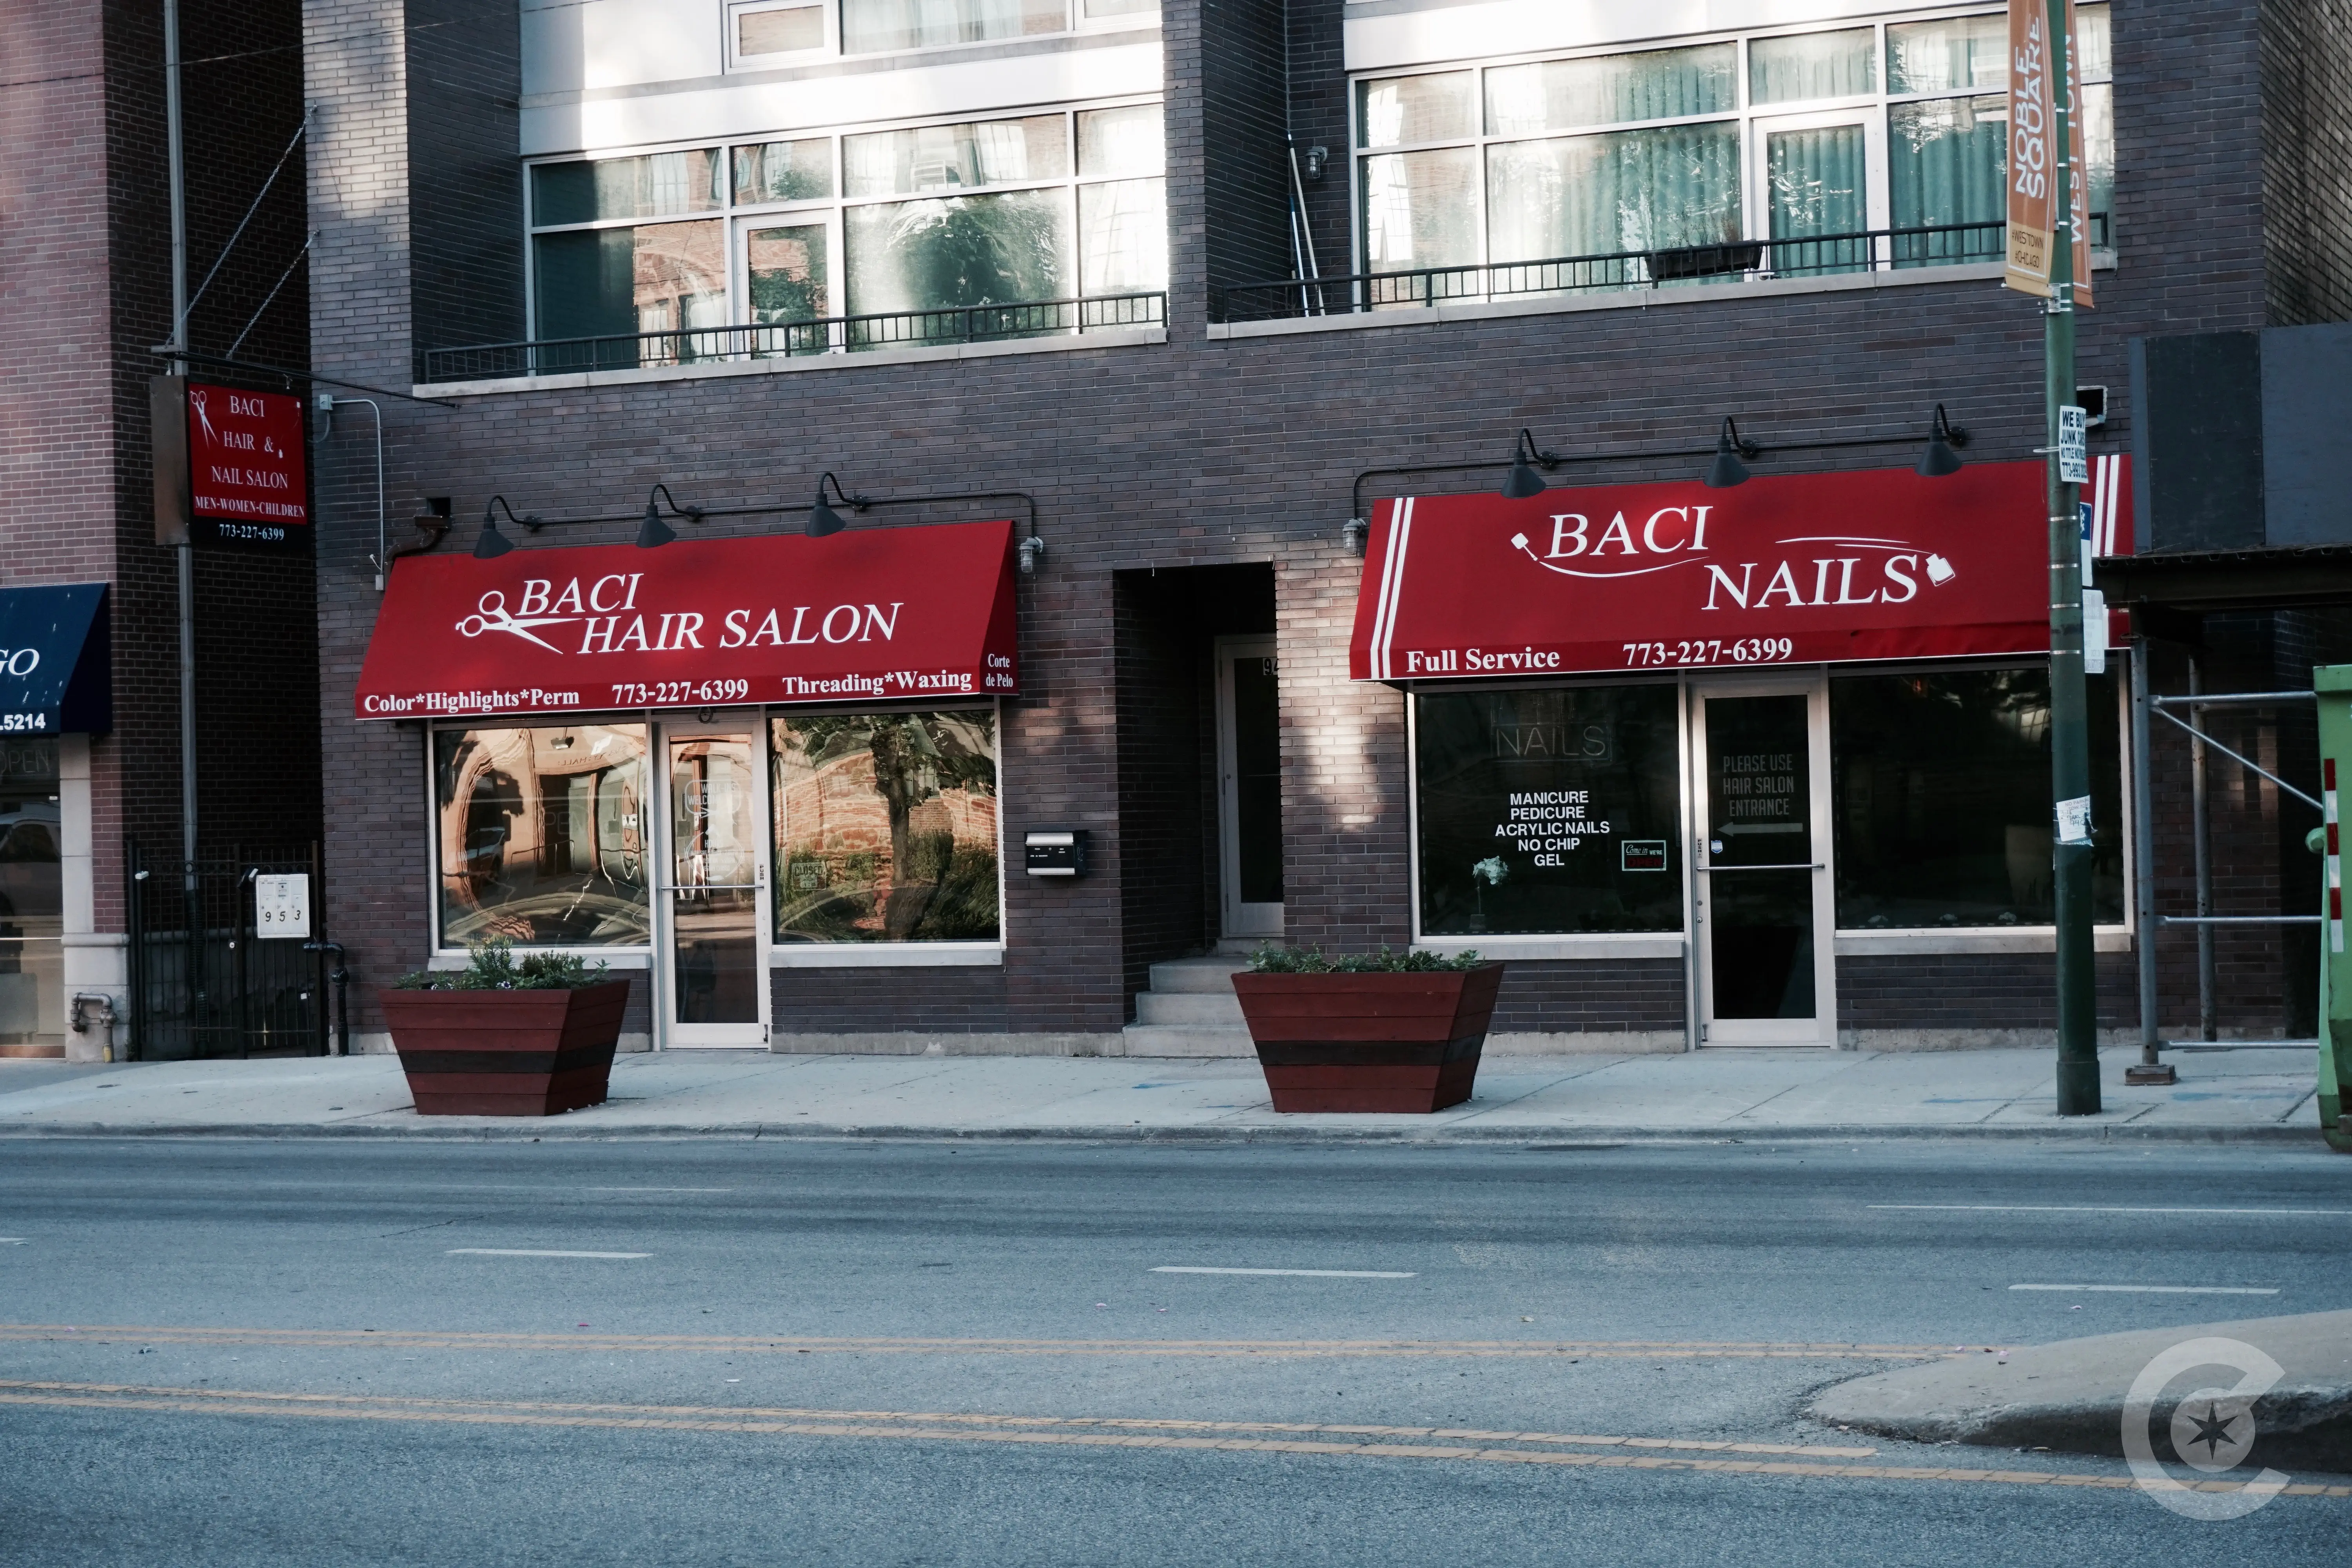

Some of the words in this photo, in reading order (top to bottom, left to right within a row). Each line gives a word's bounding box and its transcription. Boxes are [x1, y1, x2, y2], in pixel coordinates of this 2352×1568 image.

[2027, 17, 2045, 199] SQUARE
[2015, 46, 2029, 193] NOBLE
[230, 395, 265, 417] BACI
[2062, 411, 2074, 427] WE
[2076, 412, 2085, 429] BUY
[224, 431, 255, 450] HAIR
[265, 436, 274, 452] &
[2061, 429, 2076, 445] JUNK
[212, 466, 243, 485] NAIL
[247, 469, 288, 489] SALON
[195, 496, 305, 517] MEN-WOMEN-CHILDREN
[219, 524, 284, 541] 773-227-6399
[1544, 506, 1713, 558] BACI
[1701, 554, 1918, 610] NAILS
[515, 573, 644, 616] BACI
[577, 612, 704, 654] HAIR
[719, 603, 904, 648] SALON
[988, 653, 1010, 668] Corte
[1406, 649, 1458, 673] Full
[1466, 647, 1560, 671] Service
[1623, 638, 1792, 666] 773-227-6399
[985, 673, 996, 688] de
[997, 674, 1013, 688] Pelo
[612, 679, 749, 704] 773-227-6399
[1496, 726, 1606, 756] NAILS
[1723, 755, 1766, 773] PLEASE
[1770, 754, 1793, 771] USE
[1723, 778, 1751, 795] HAIR
[1755, 776, 1794, 794] SALON
[688, 795, 722, 805] WELCOM
[1510, 791, 1588, 805] MANICURE
[1730, 798, 1789, 817] ENTRANCE
[1511, 806, 1585, 820] PEDICURE
[1495, 822, 1563, 837] ACRYLIC
[1565, 821, 1610, 834] NAILS
[1518, 838, 1541, 851] NO
[1545, 838, 1580, 850] CHIP
[1626, 844, 1641, 854] Come
[1534, 853, 1564, 866] GEL
[1626, 857, 1662, 867] OPEN
